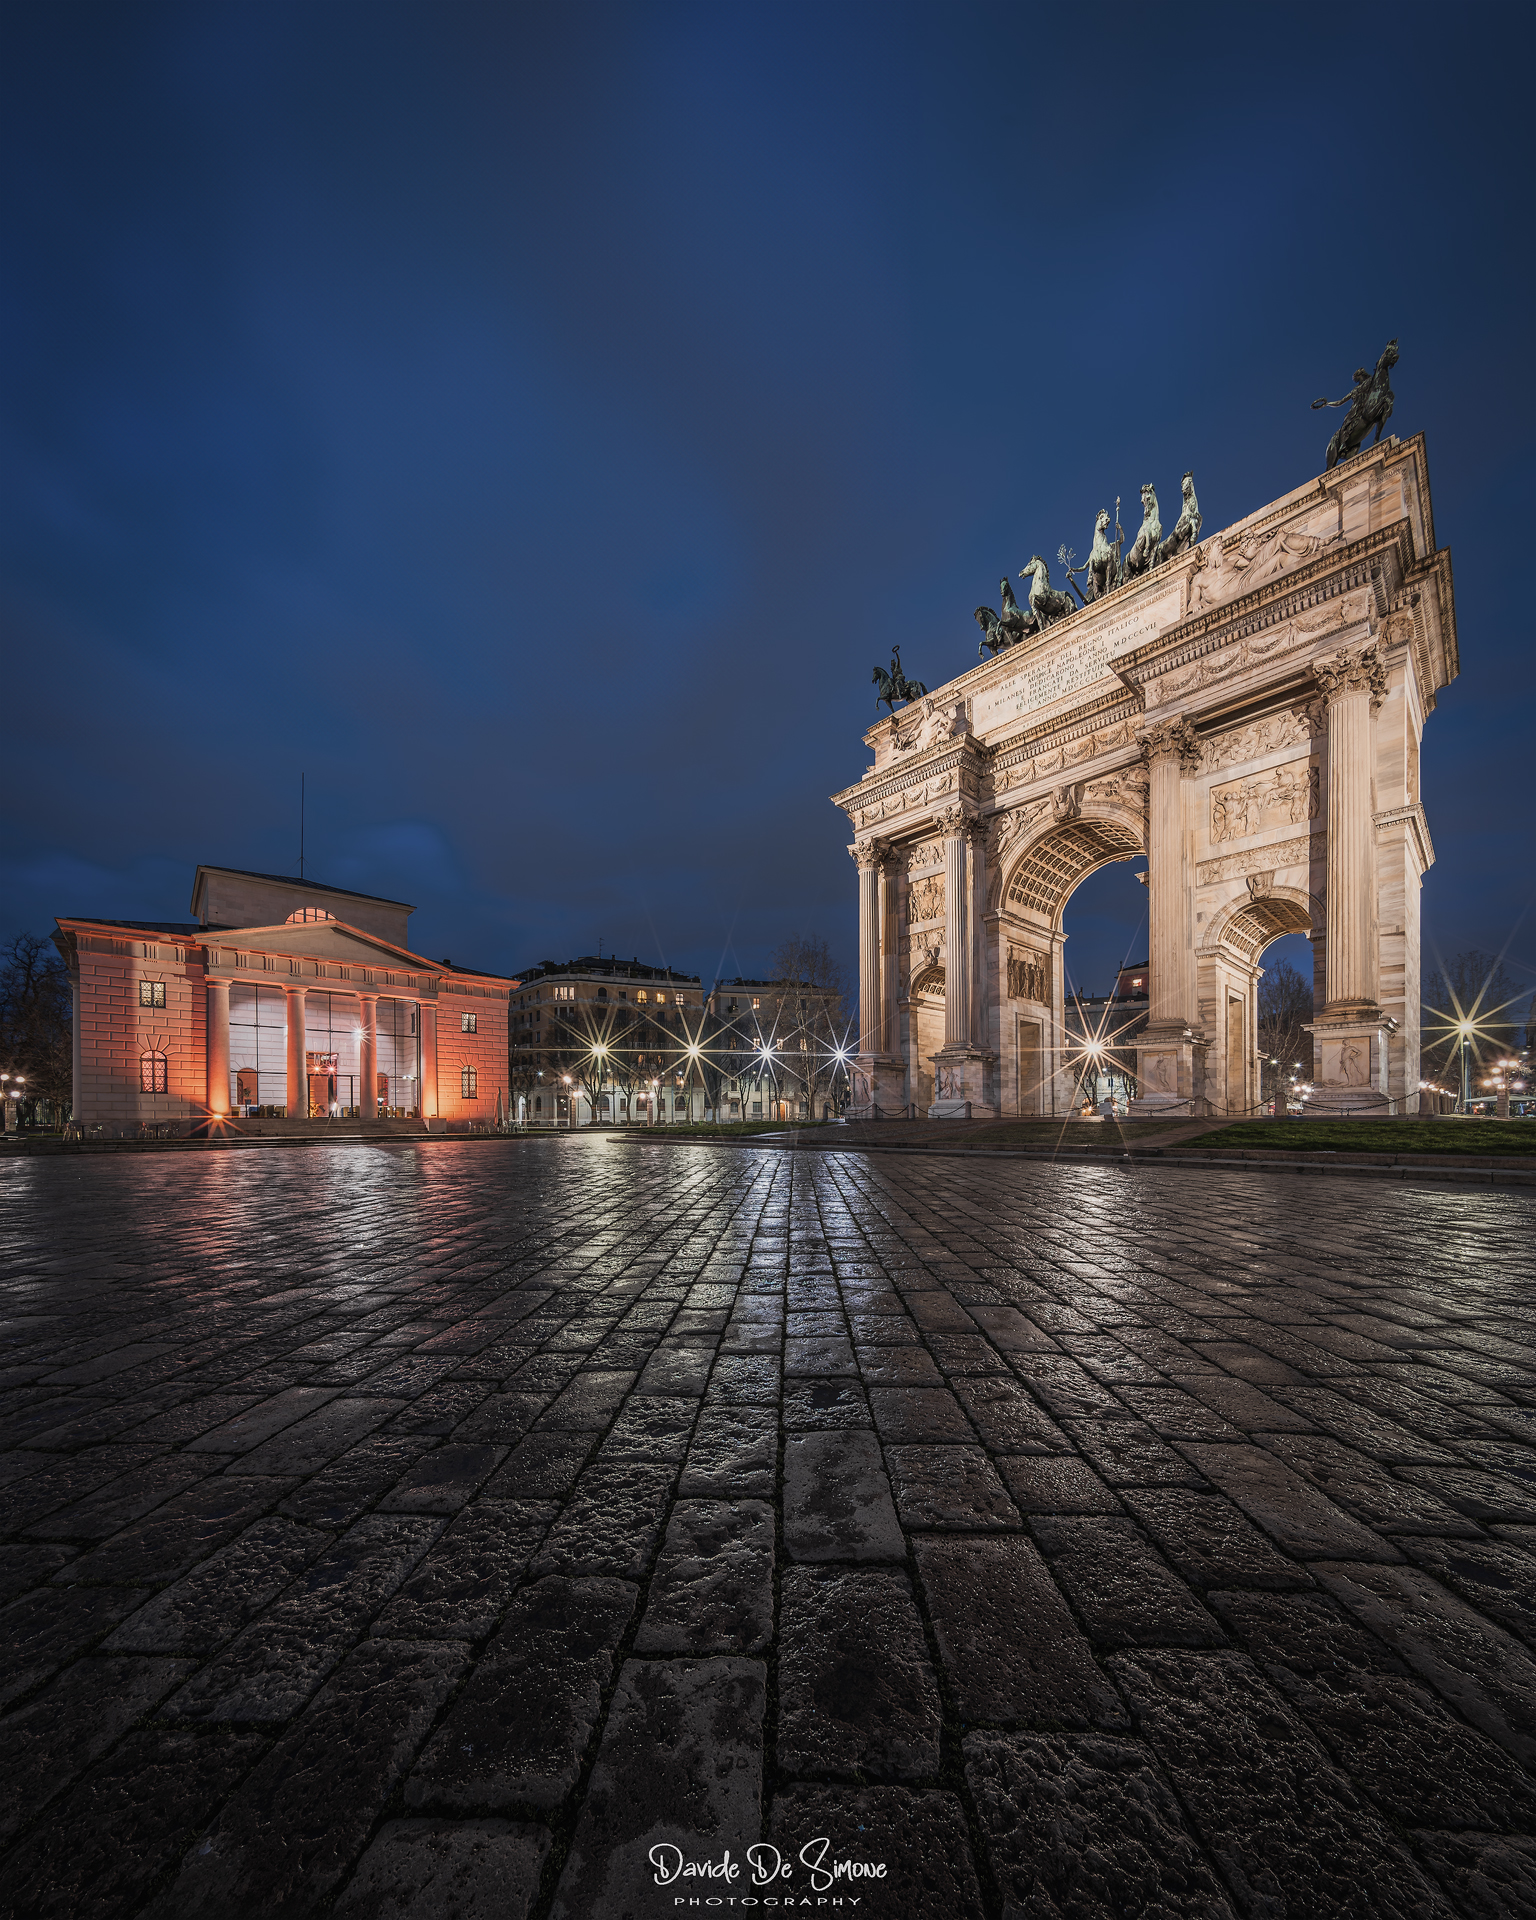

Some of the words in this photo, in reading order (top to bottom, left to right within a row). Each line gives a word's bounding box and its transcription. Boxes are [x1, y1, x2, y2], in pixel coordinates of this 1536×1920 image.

[994, 688, 1025, 707] MILANESI
[1029, 664, 1075, 689] DEDICARONO
[1088, 647, 1108, 661] ANNO
[1113, 621, 1156, 648] MDCCCVII
[1000, 680, 1016, 691] ALLE
[1020, 659, 1055, 680] SPERANZE
[1060, 650, 1072, 660] DEL
[1078, 635, 1103, 652] REGNO
[1107, 616, 1139, 636] ITALICO
[1028, 668, 1052, 684] AUSPICE
[1056, 646, 1096, 669] NAPOLEONE
[1029, 676, 1063, 696] FRANCATI
[1085, 650, 1115, 669] SERVITU
[1016, 684, 1060, 710] FELICEMENTE
[1037, 692, 1057, 705] ANNO
